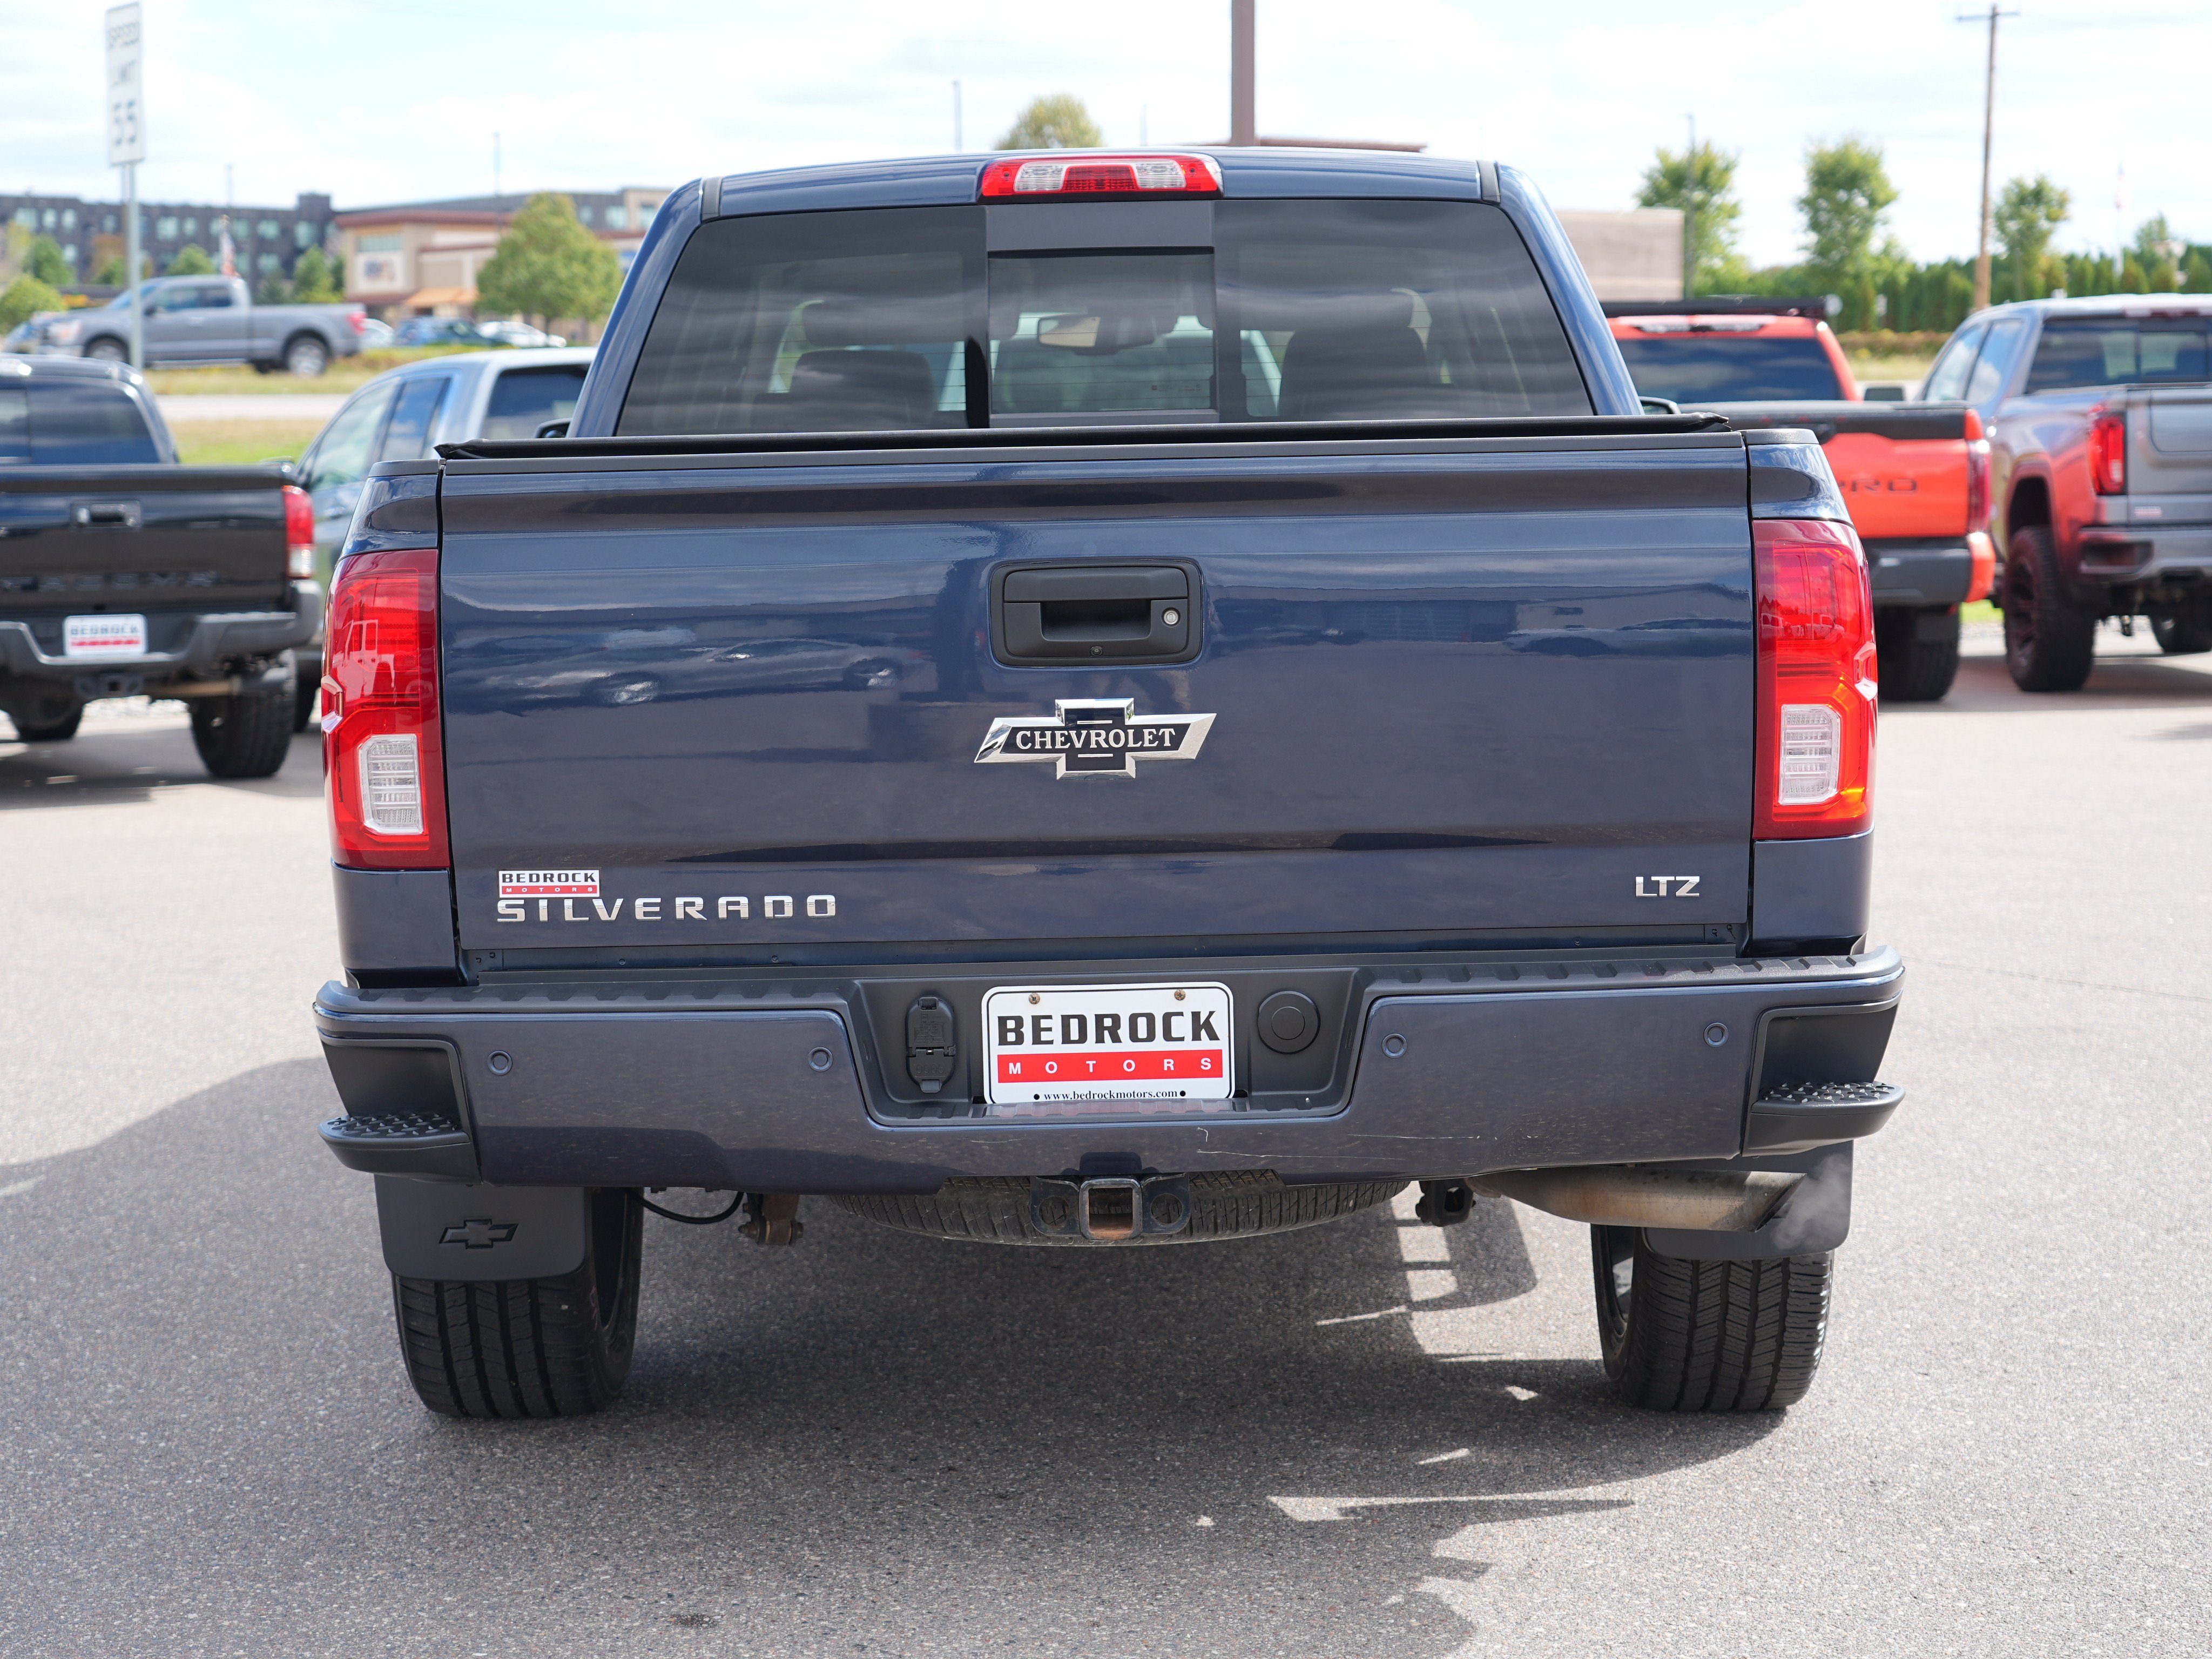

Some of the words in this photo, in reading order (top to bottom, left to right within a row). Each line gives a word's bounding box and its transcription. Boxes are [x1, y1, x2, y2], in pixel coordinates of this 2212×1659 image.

[113, 99, 137, 146] 55
[1015, 728, 1176, 750] CHEVROLET
[502, 872, 596, 883] BEDROCK
[1635, 875, 1701, 898] LTZ
[497, 894, 836, 922] SILVERADO
[997, 1010, 1221, 1046] BEDROCK
[1008, 1057, 1212, 1075] MOTORS
[1043, 1090, 1178, 1101] www.bedrockmotors.com
